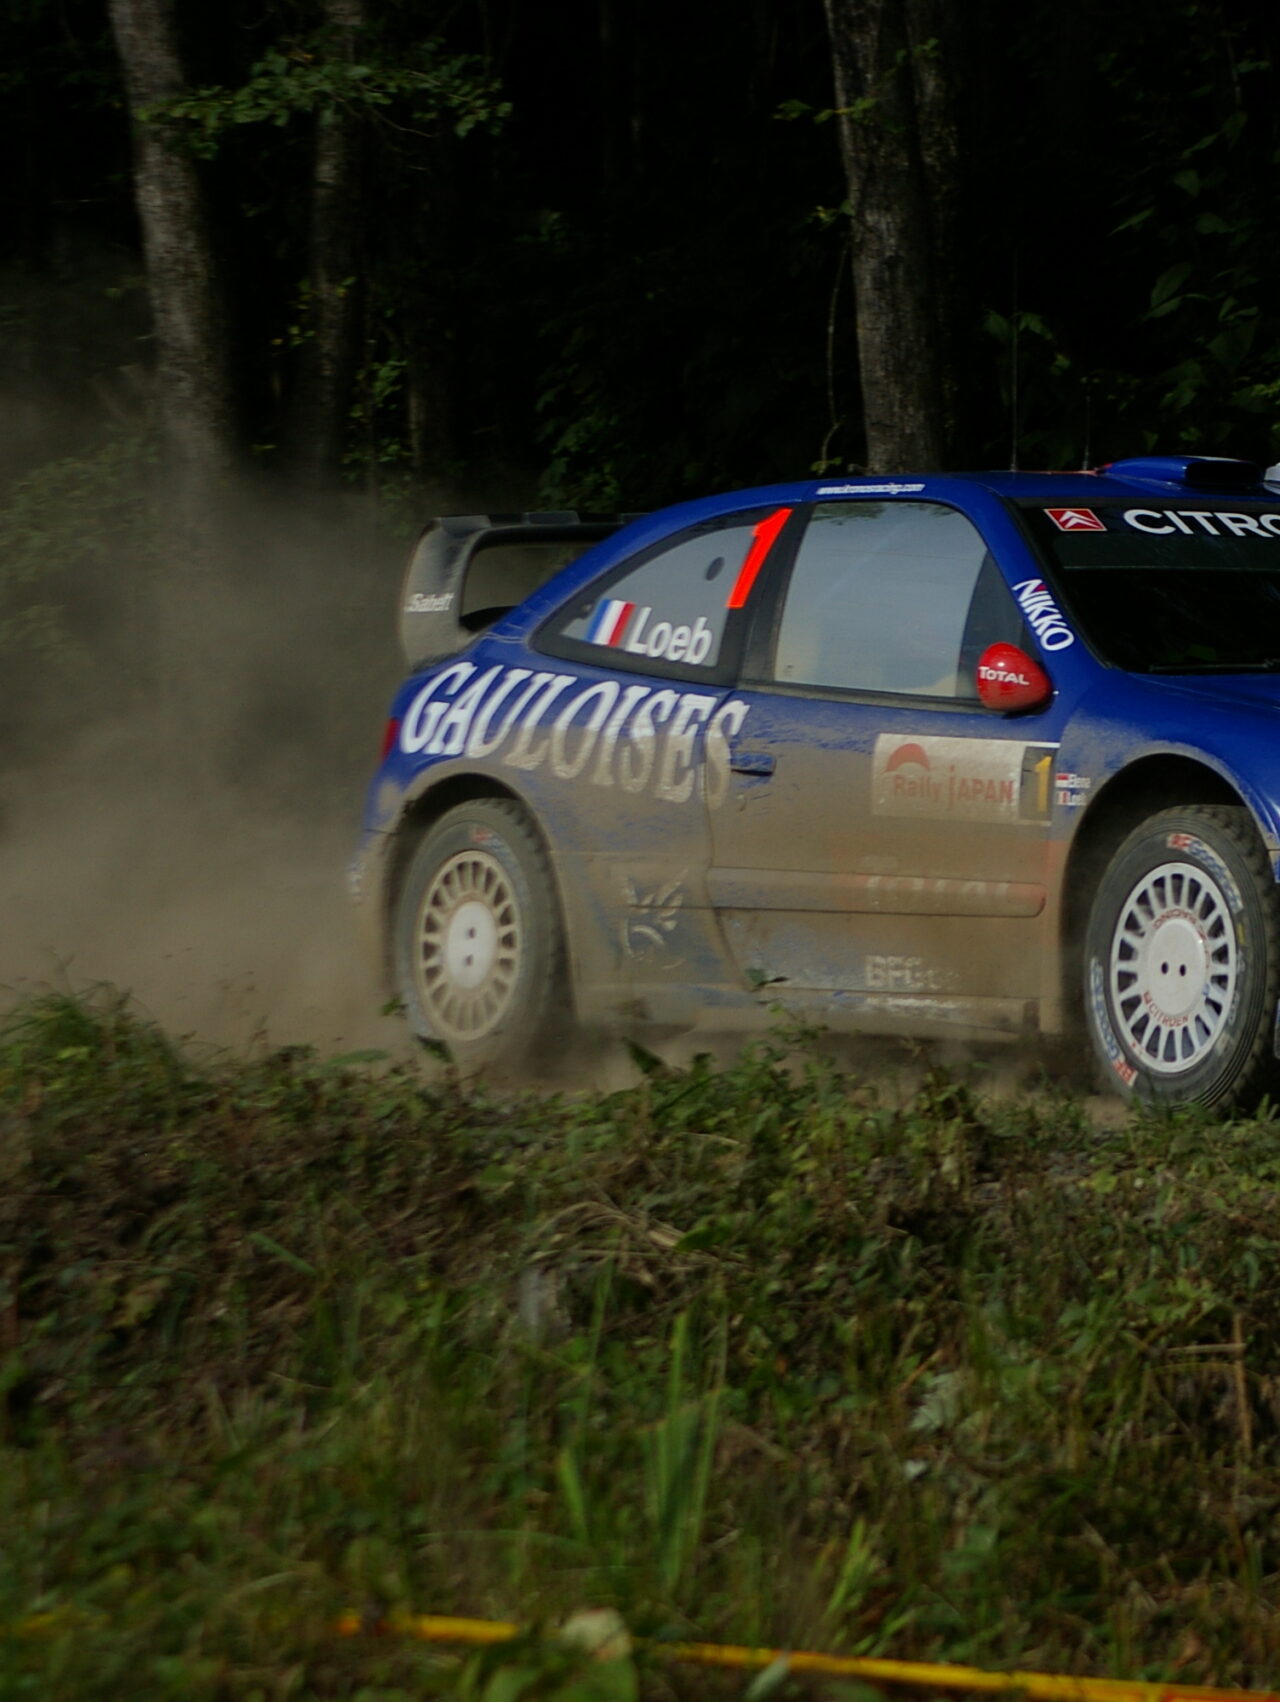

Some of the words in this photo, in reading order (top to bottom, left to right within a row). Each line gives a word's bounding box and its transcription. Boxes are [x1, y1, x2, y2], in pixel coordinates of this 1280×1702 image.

[727, 507, 794, 609] 1
[624, 606, 713, 665] Loeb
[1011, 578, 1076, 652] NIKKO
[978, 665, 1030, 686] TOTAL
[400, 661, 751, 810] GAULOISES
[1034, 755, 1053, 813] 1
